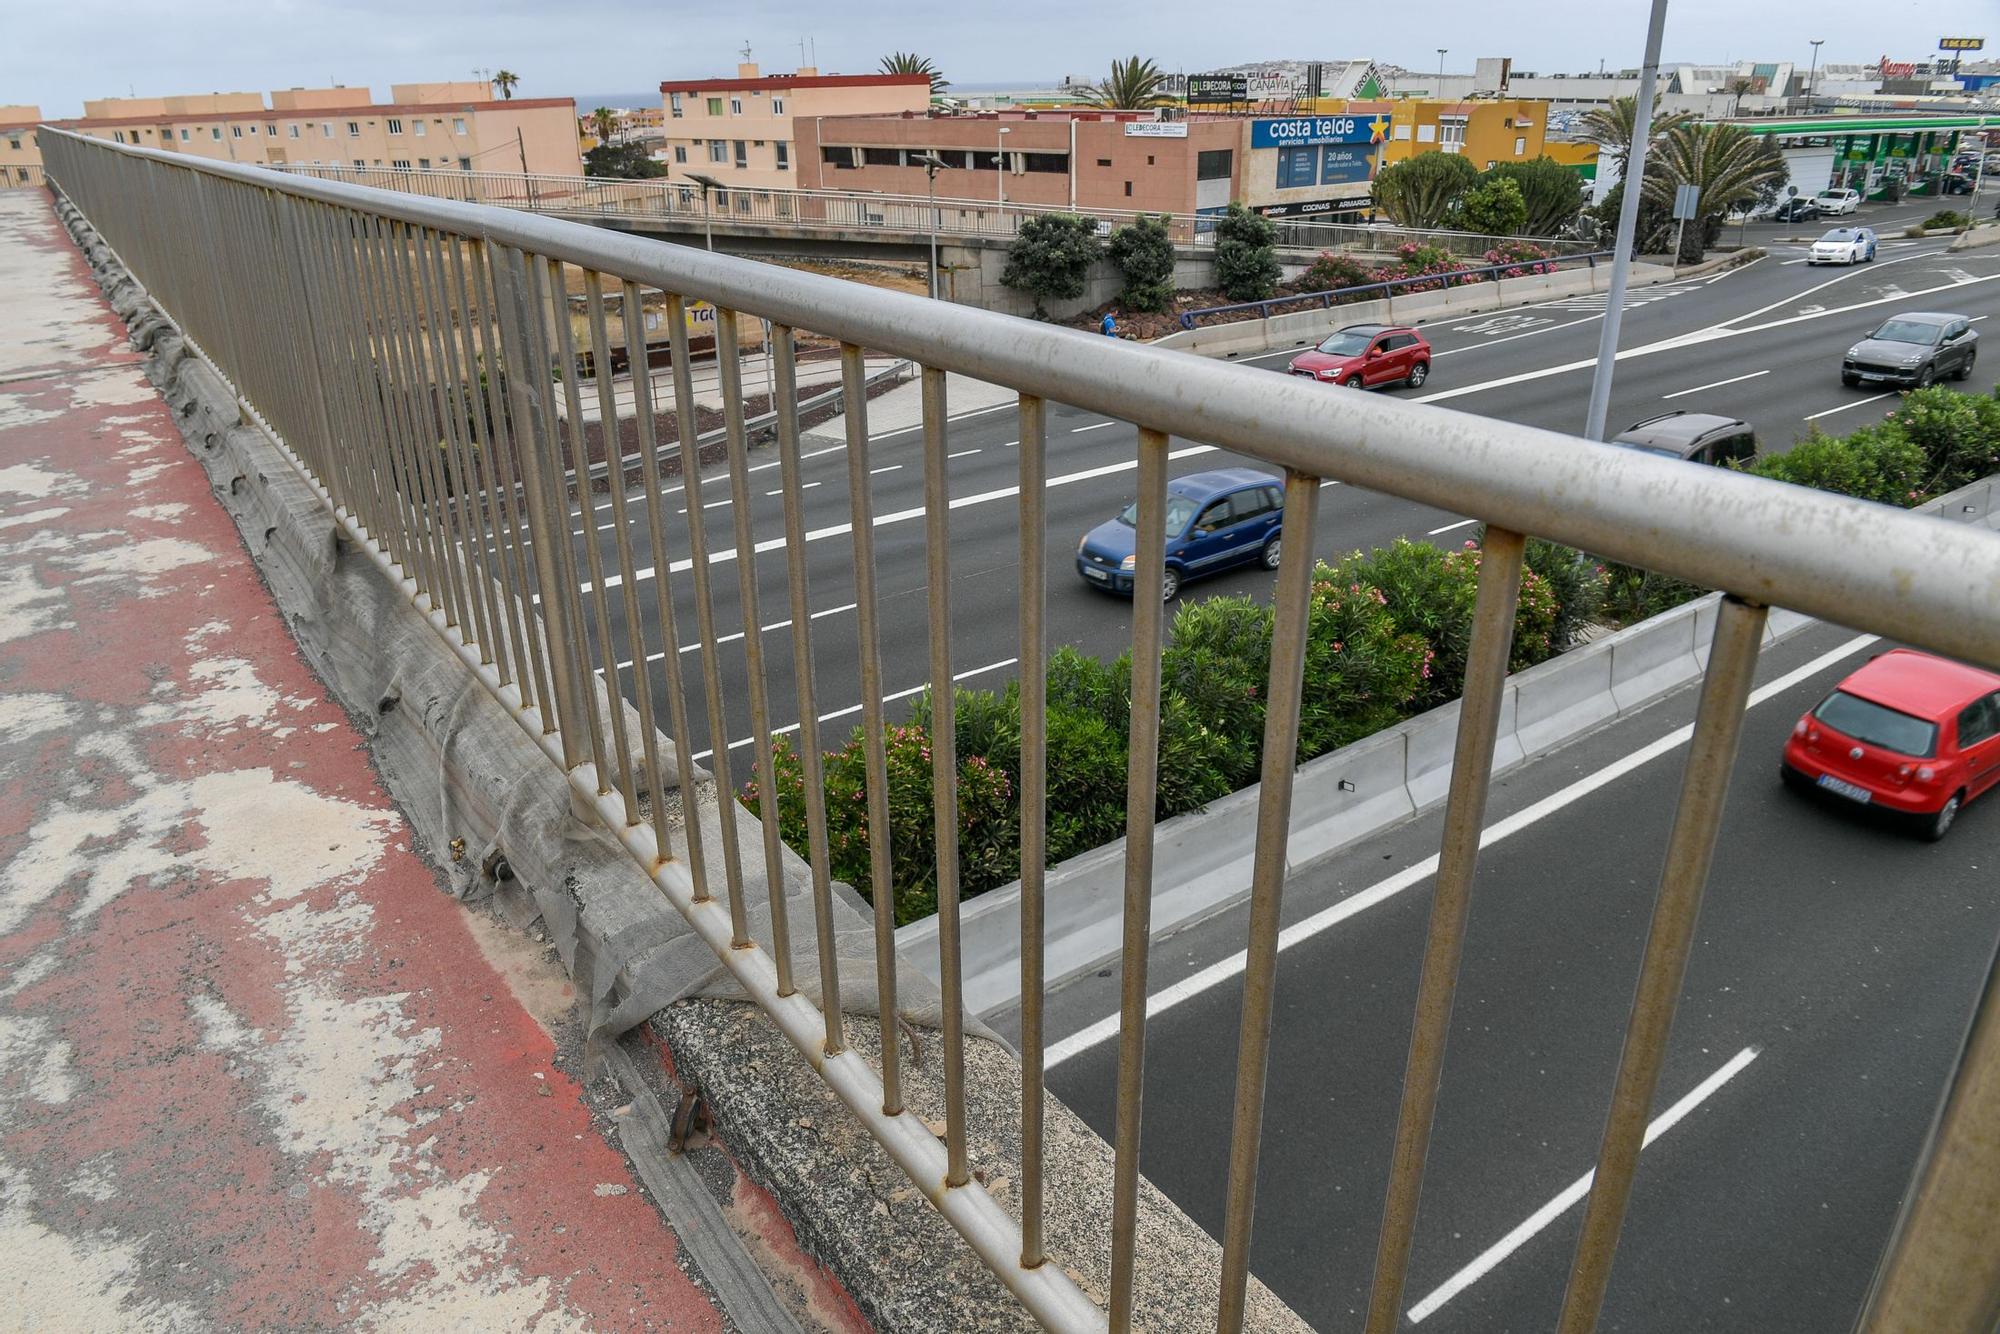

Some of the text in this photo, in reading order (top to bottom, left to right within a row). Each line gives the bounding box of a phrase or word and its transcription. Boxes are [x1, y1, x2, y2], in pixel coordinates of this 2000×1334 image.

[1941, 40, 1980, 48] IKEA
[1351, 62, 1389, 98] LEROY MERLIN
[1199, 81, 1232, 91] LEDECORA
[1269, 118, 1354, 138] costa telde
[1279, 136, 1344, 146] servicios inmobiliarios
[1327, 151, 1352, 161] 20 años
[1302, 203, 1330, 212] COCINAS
[1338, 199, 1371, 209] ARMARIOS
